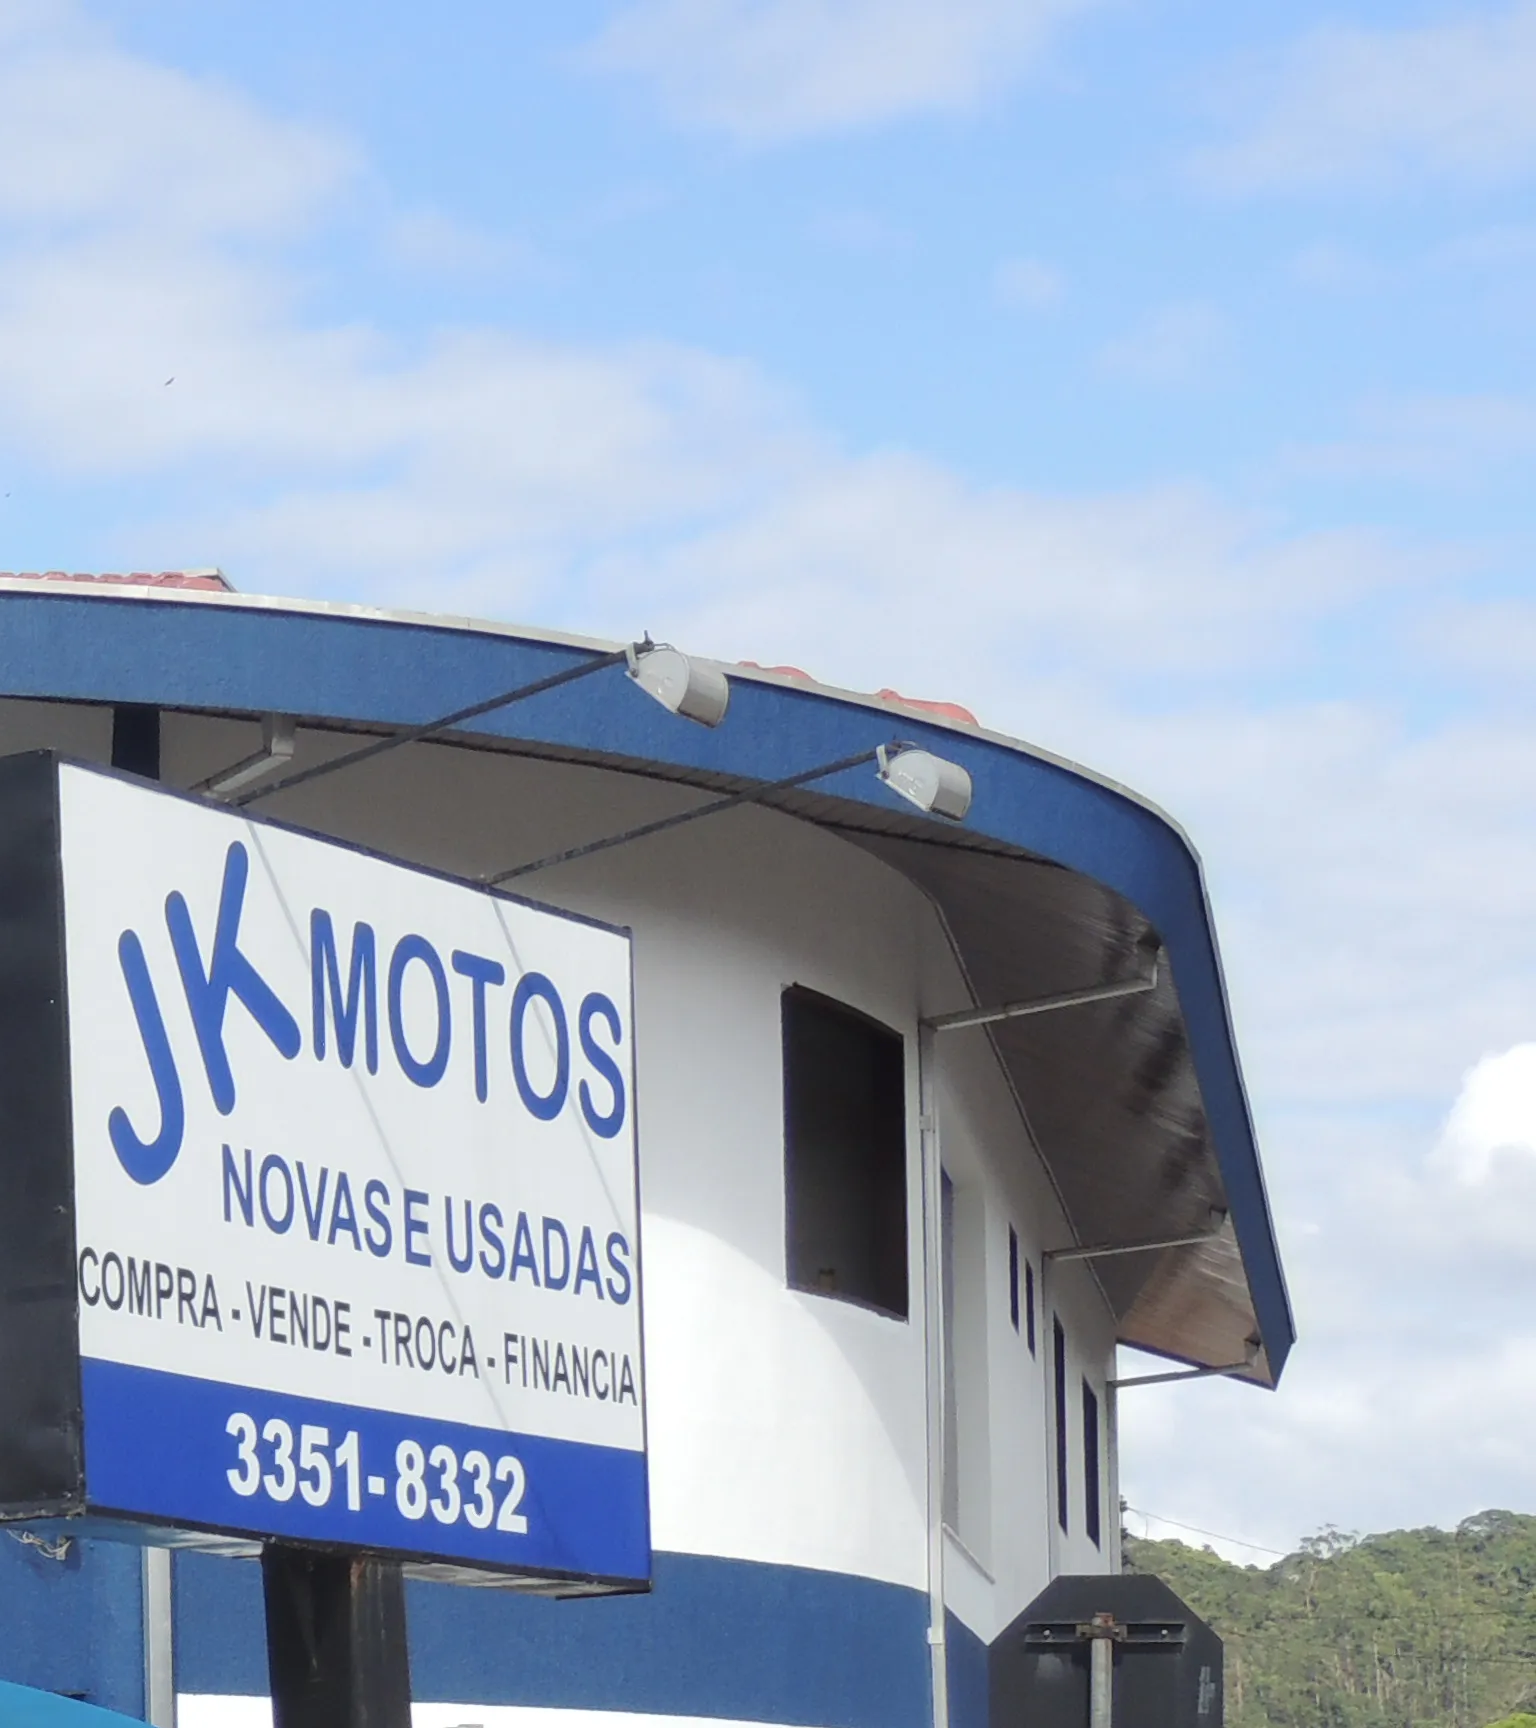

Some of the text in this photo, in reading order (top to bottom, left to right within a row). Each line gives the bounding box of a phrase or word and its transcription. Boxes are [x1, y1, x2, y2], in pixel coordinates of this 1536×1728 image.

[107, 840, 626, 1185] JK MOTOS
[221, 1143, 632, 1306] NOVAS E USADAS
[78, 1246, 223, 1332] COMPRA
[247, 1280, 352, 1359] VENDE
[373, 1310, 479, 1381] TROCA
[504, 1331, 638, 1407] FINANCIA
[225, 1411, 529, 1535] 3351-8332
